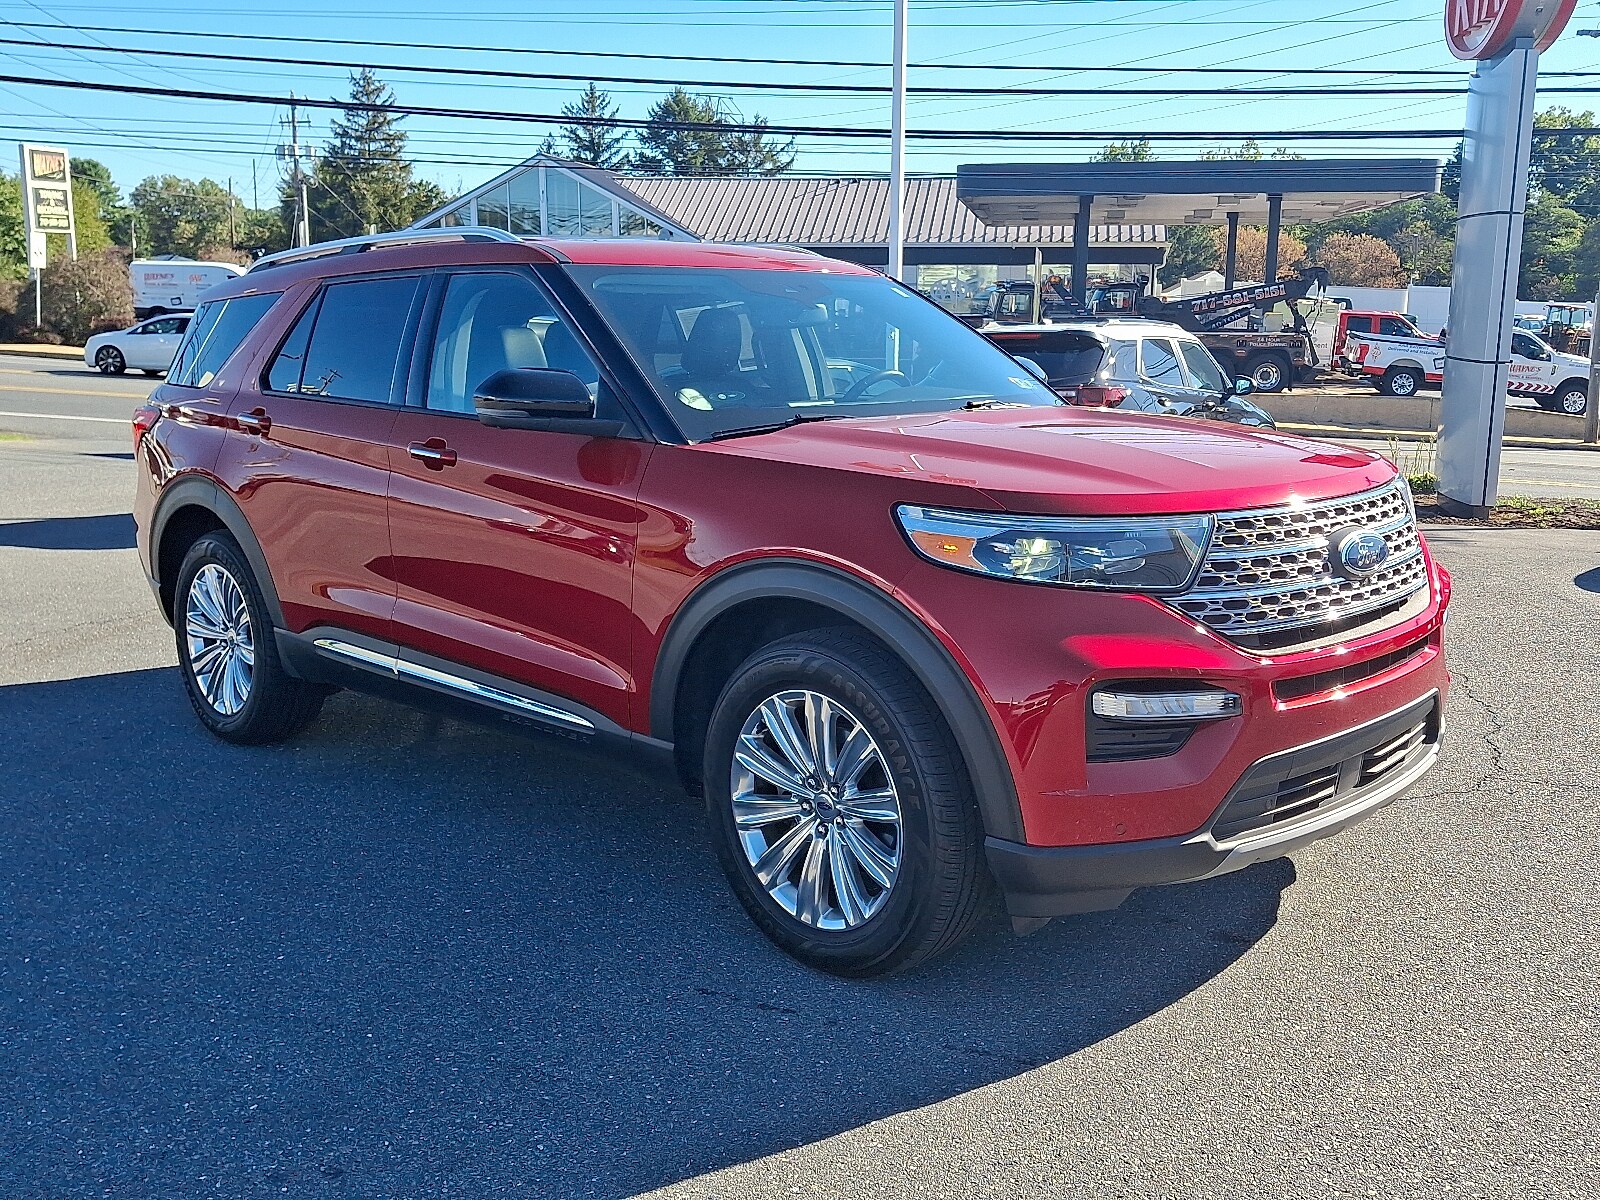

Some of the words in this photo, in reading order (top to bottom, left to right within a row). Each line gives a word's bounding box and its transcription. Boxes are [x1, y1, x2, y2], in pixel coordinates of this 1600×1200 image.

[1191, 284, 1287, 312] 717-581-5151
[1223, 312, 1241, 324] TON
[1357, 541, 1381, 567] Ford
[831, 673, 922, 811] ASSURANCE
